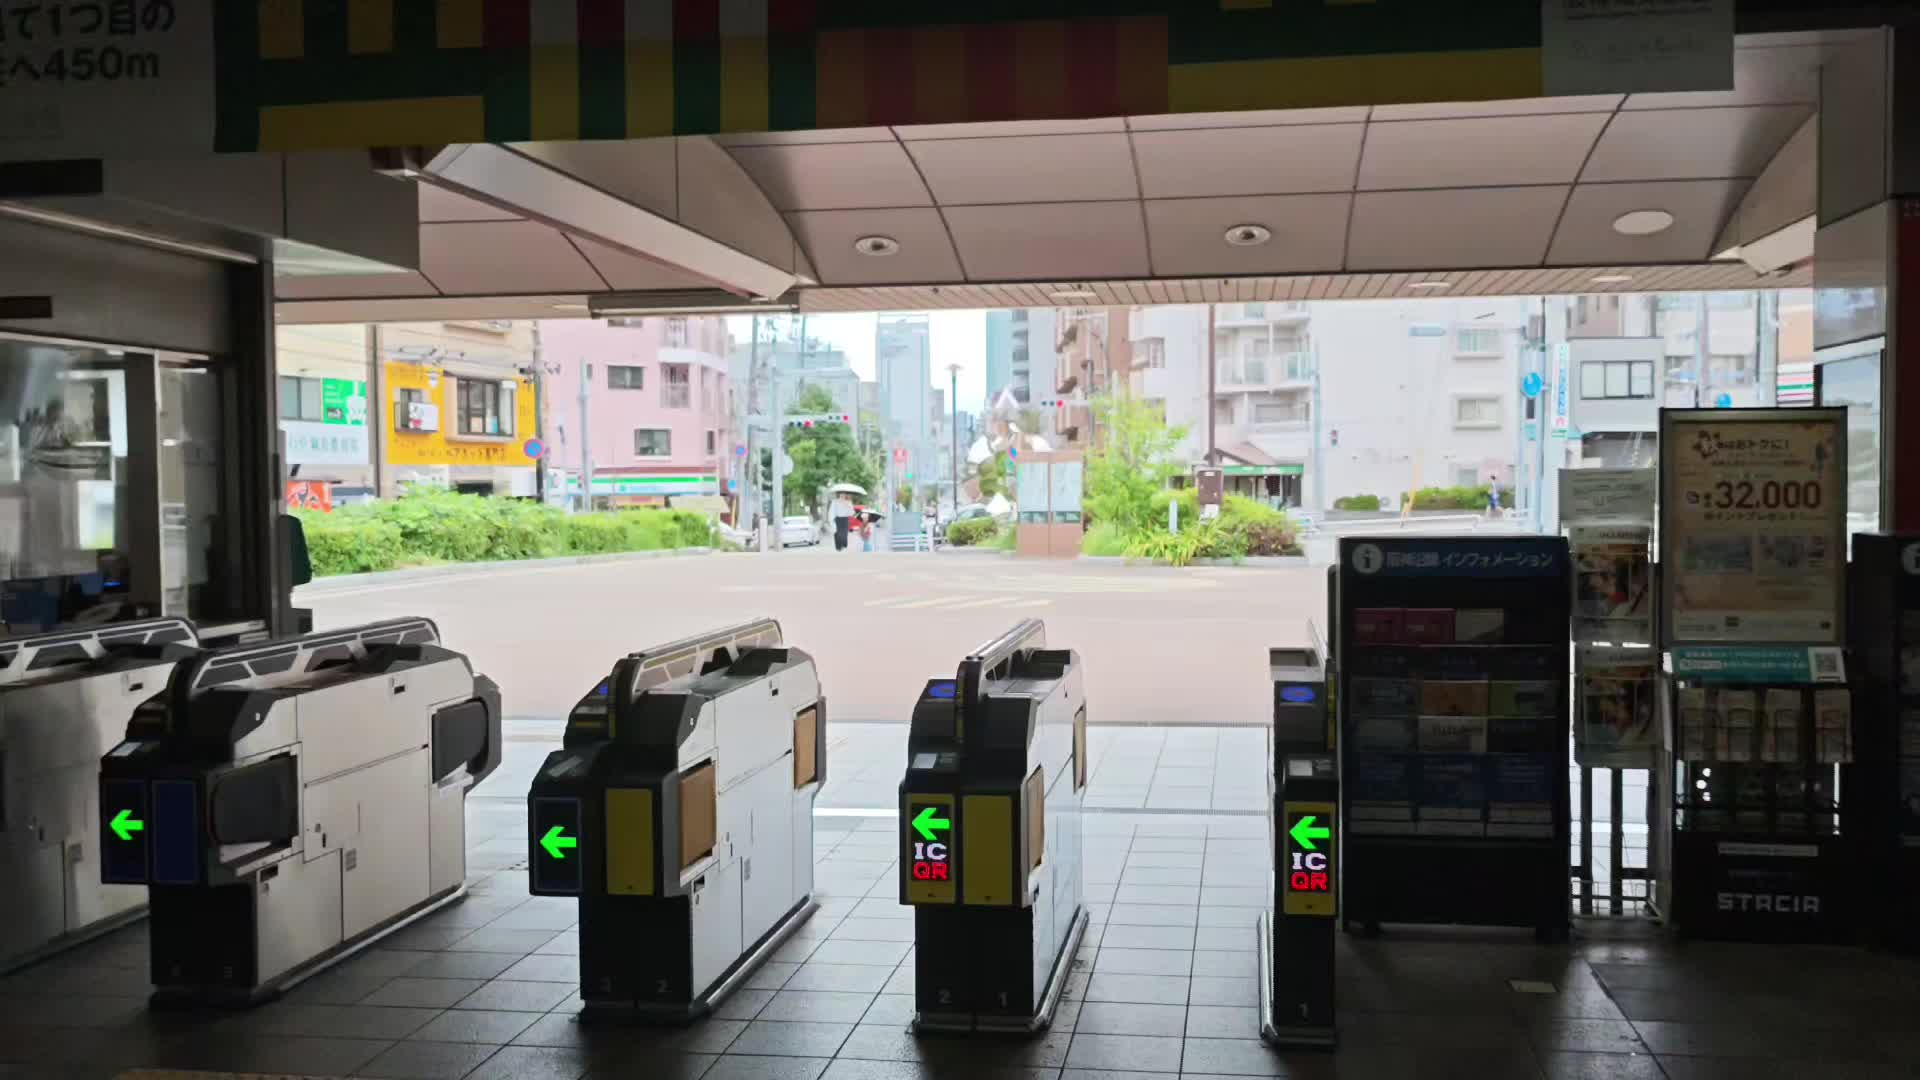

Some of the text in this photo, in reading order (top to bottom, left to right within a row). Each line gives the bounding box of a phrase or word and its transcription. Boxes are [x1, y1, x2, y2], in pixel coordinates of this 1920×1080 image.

[914, 842, 947, 861] IC
[1292, 852, 1327, 871] IC
[913, 862, 948, 881] QR
[1291, 871, 1328, 891] QR
[1717, 891, 1821, 913] STACIA
